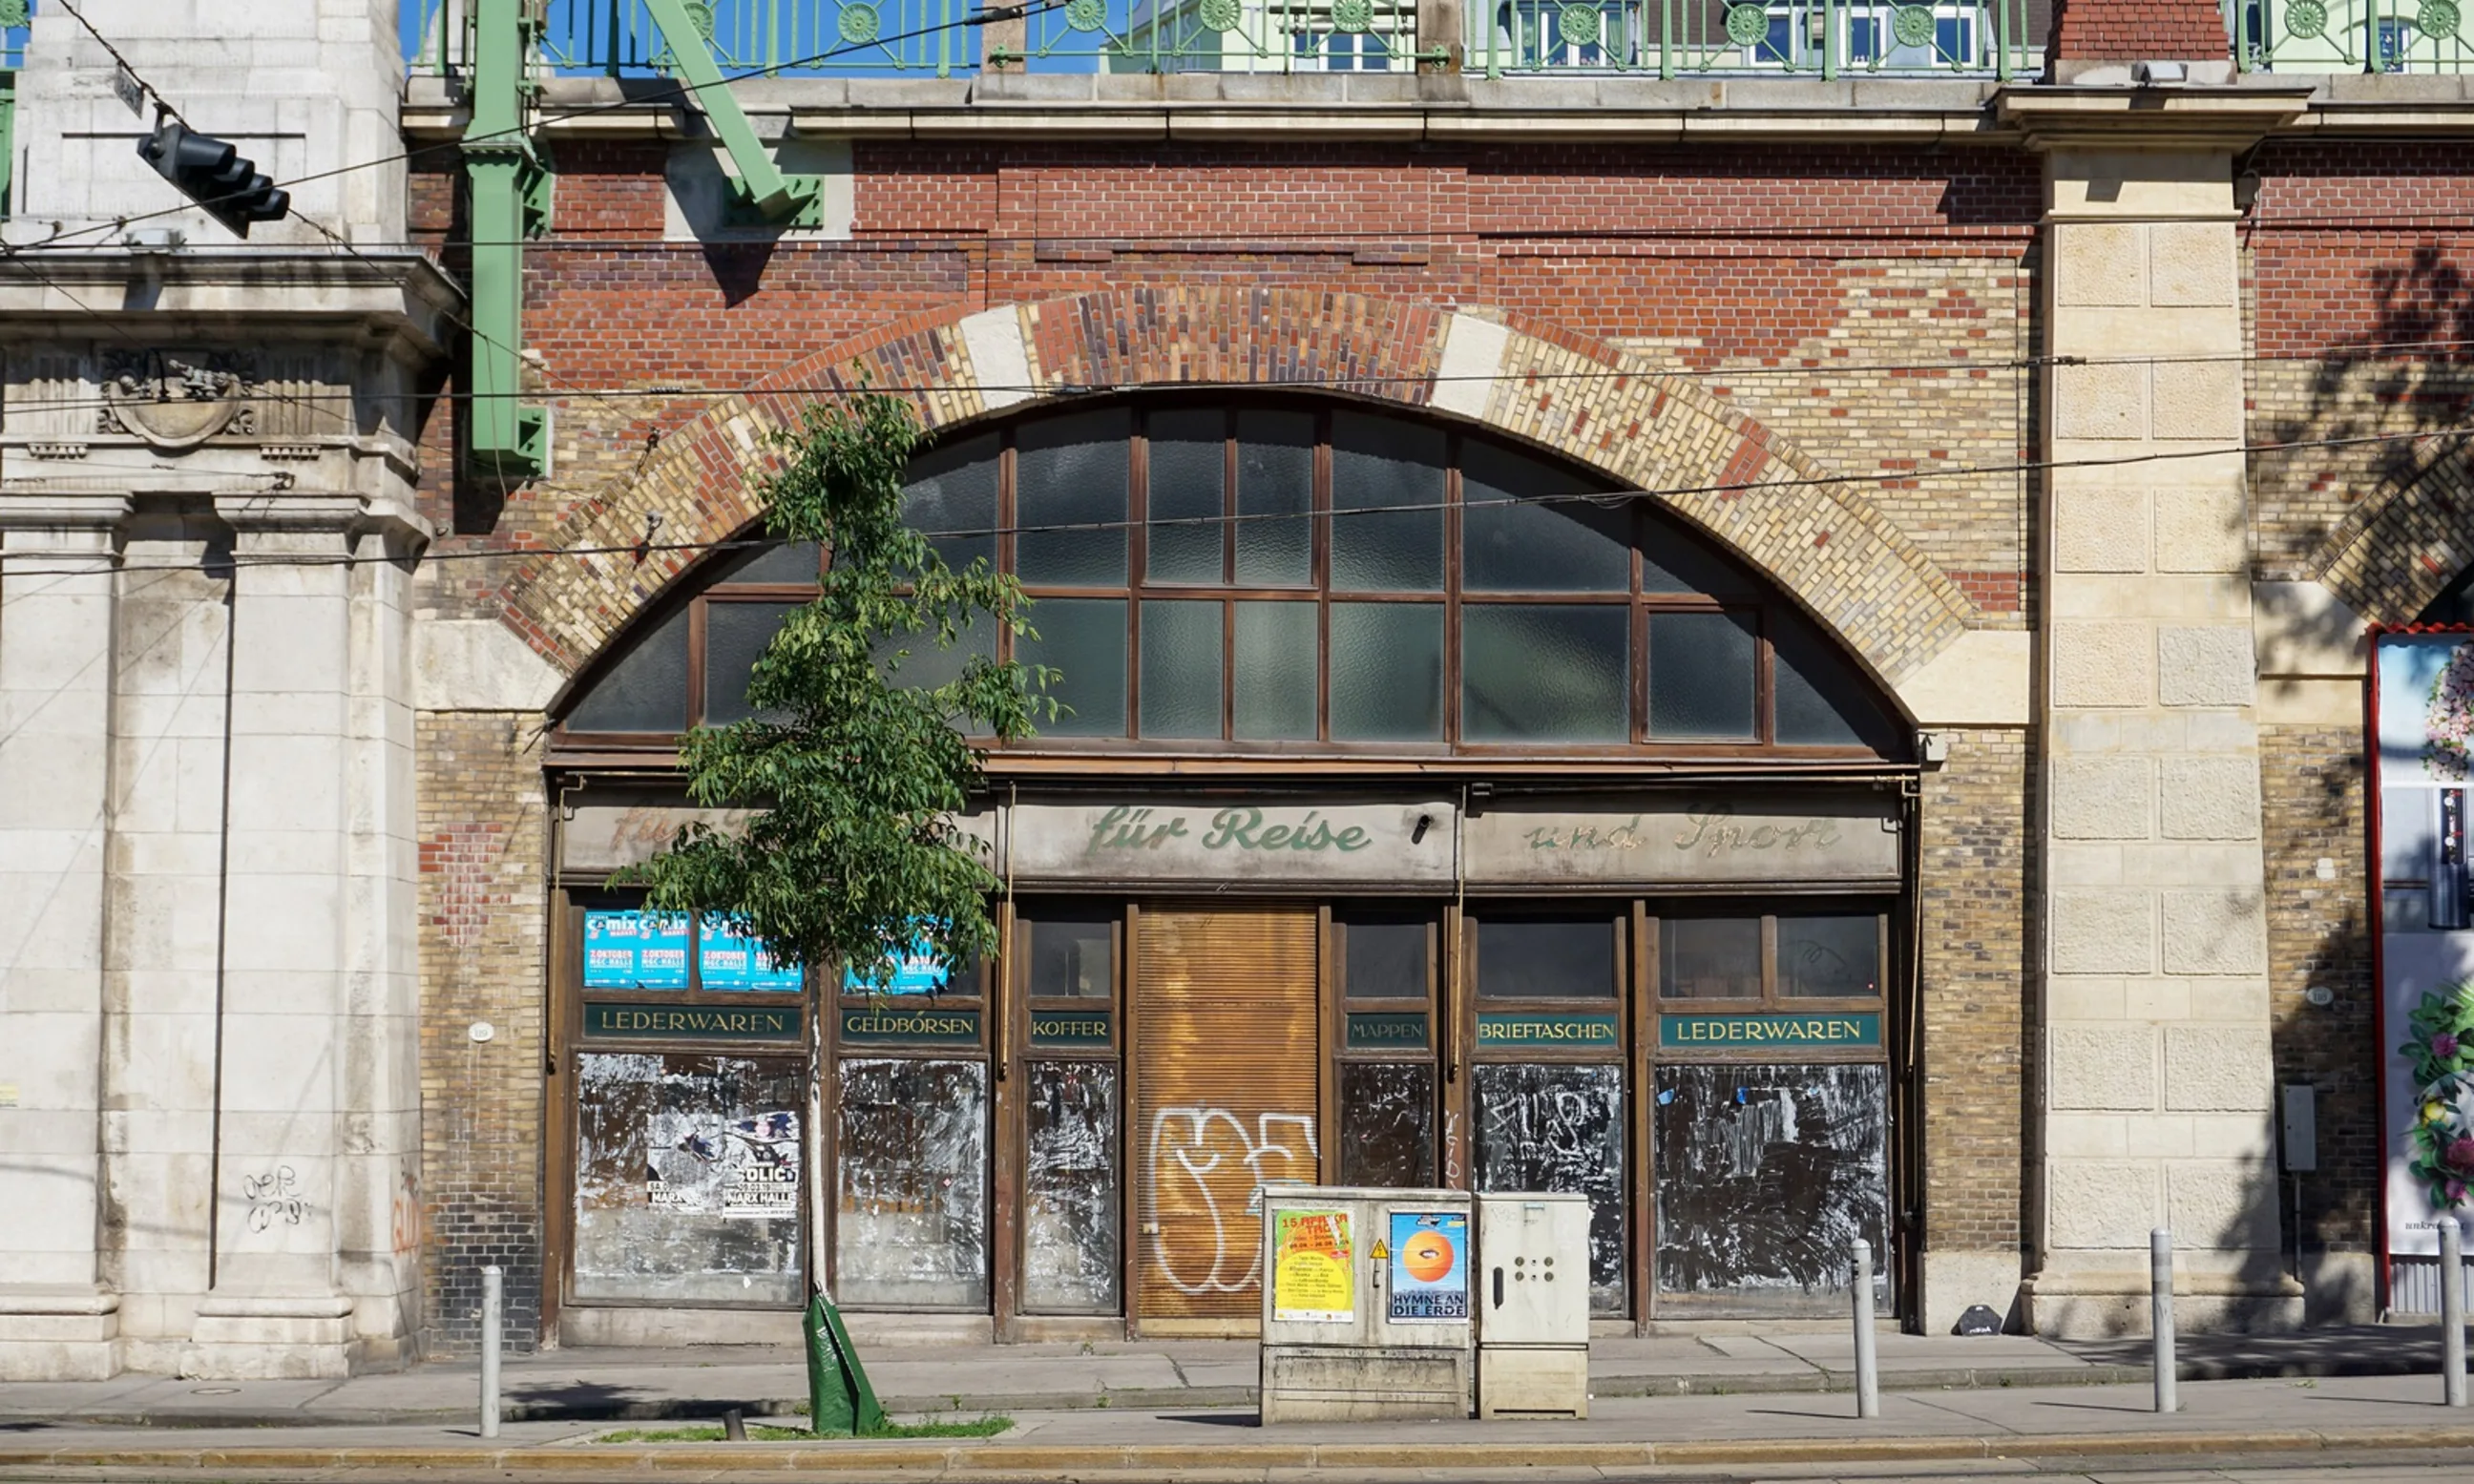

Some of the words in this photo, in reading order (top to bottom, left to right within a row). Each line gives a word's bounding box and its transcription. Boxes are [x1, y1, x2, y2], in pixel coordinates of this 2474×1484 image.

[1085, 805, 1189, 857] für
[1202, 806, 1373, 851] Reise
[1522, 812, 1647, 849] und
[1673, 804, 1843, 857] Sport
[601, 1011, 783, 1033] LEDERWAREN
[1032, 1021, 1107, 1035] KOFFER
[1351, 1023, 1423, 1038] MAPPEN
[1479, 1022, 1615, 1039] BRIEFTASCHEN
[1677, 1021, 1861, 1040] LEDERWAREN
[1394, 1294, 1442, 1305] HYMNE
[1445, 1294, 1463, 1305] AN
[1394, 1306, 1419, 1315] DIE
[1424, 1306, 1463, 1315] ERDE
